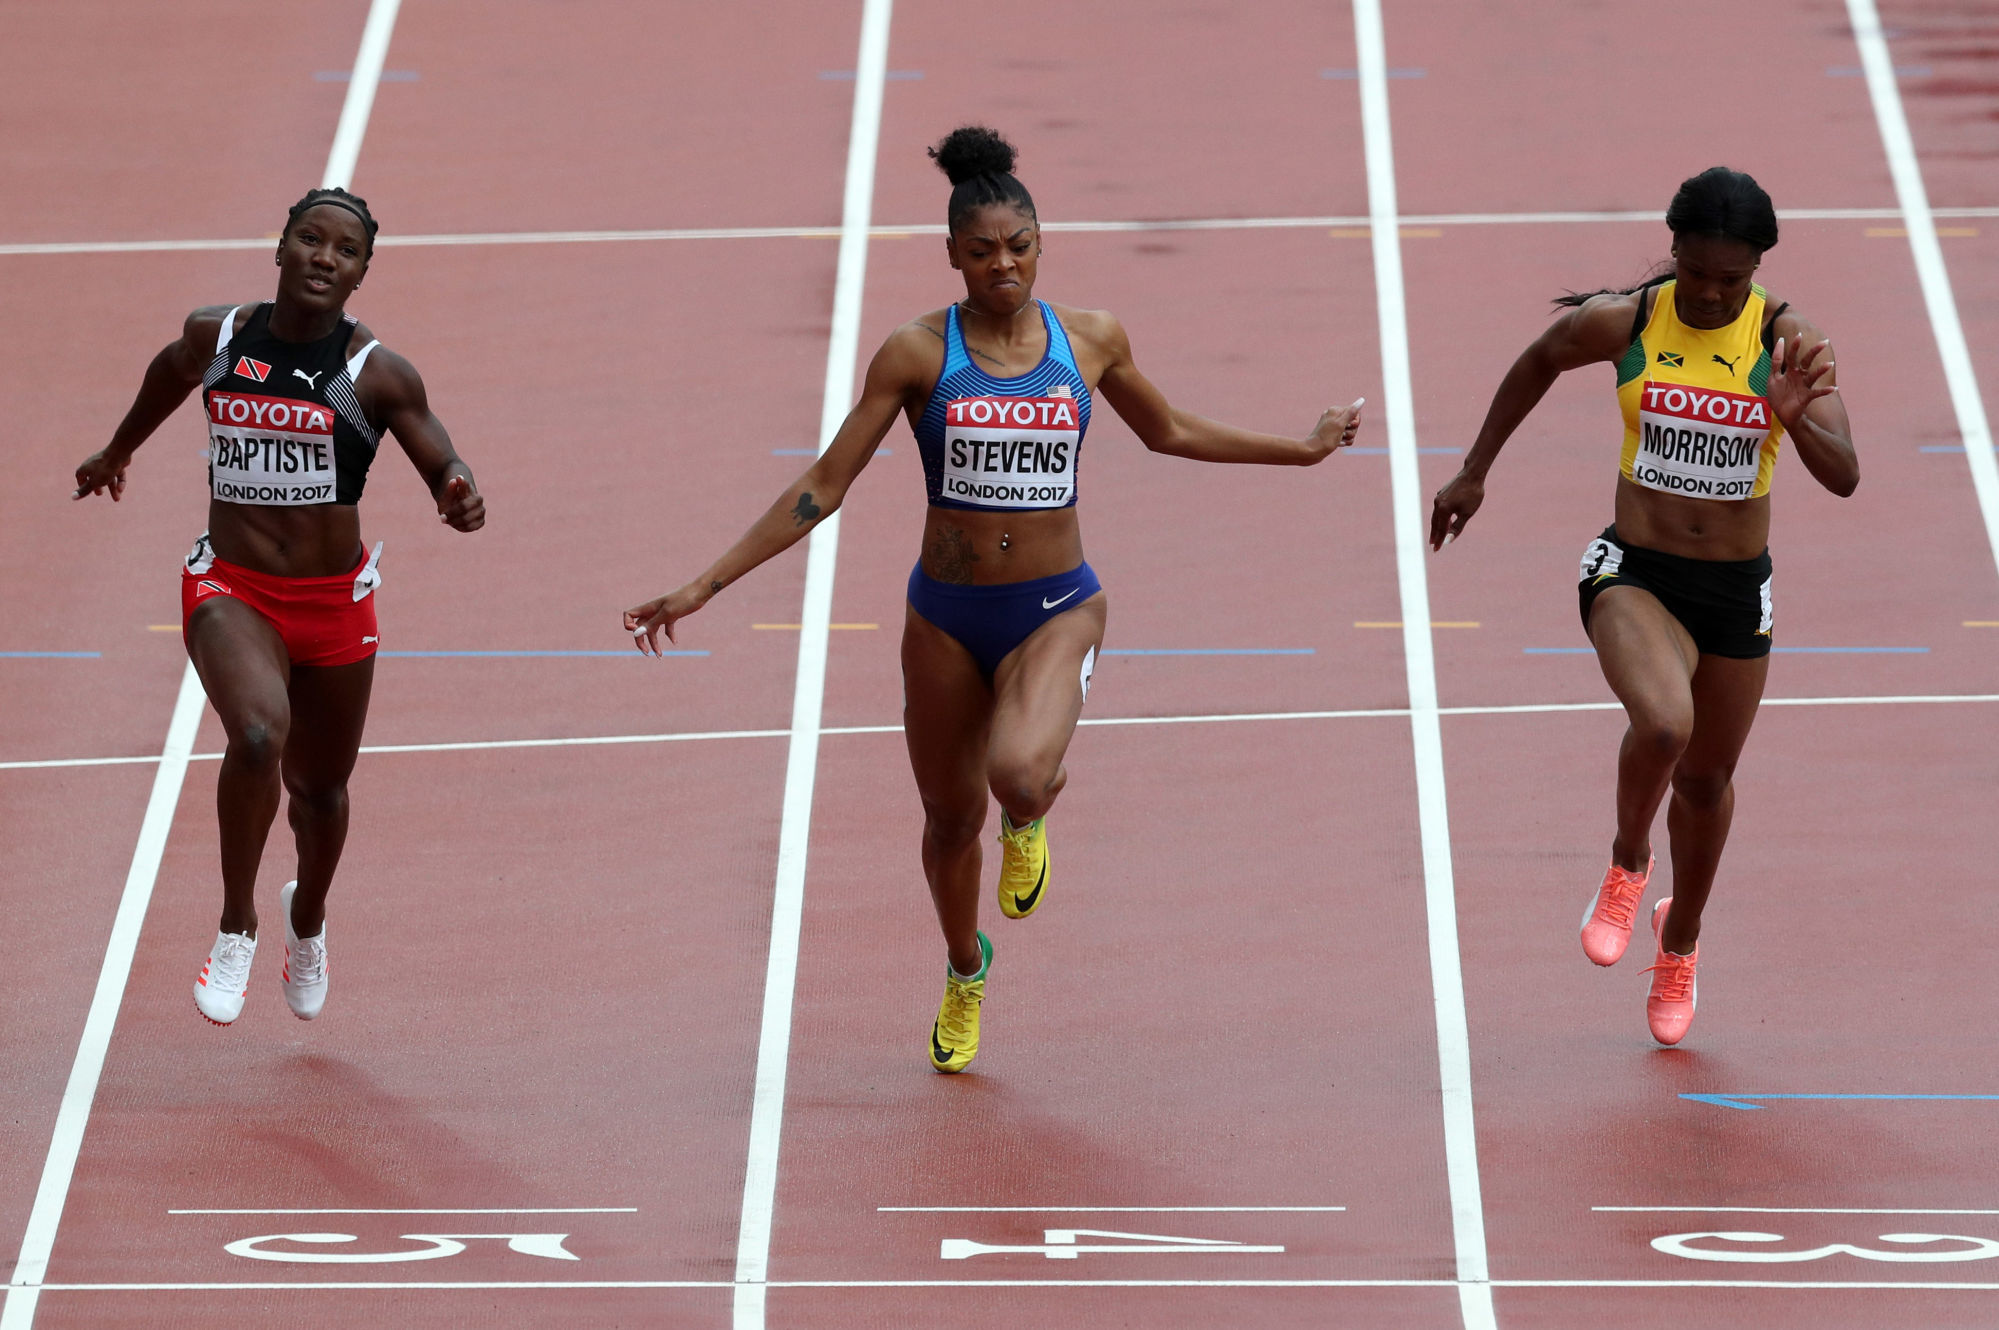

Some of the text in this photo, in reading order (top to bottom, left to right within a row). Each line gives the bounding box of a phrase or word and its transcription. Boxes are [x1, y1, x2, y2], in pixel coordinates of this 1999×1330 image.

[212, 397, 328, 431] TOYOTA
[951, 400, 1074, 426] TOYOTA
[1647, 387, 1767, 425] TOYOTA
[216, 434, 329, 473] BAPTISTE
[950, 438, 1069, 474] STEVENS
[1643, 422, 1759, 468] MORRISON
[217, 481, 333, 501] LONDON 2017
[948, 478, 1068, 501] LONDON 2017
[1637, 465, 1753, 496] LONDON 2017
[1586, 543, 1608, 576] 3
[223, 1232, 581, 1263] 5
[940, 1229, 1285, 1259] 4
[1650, 1231, 1999, 1262] 3
